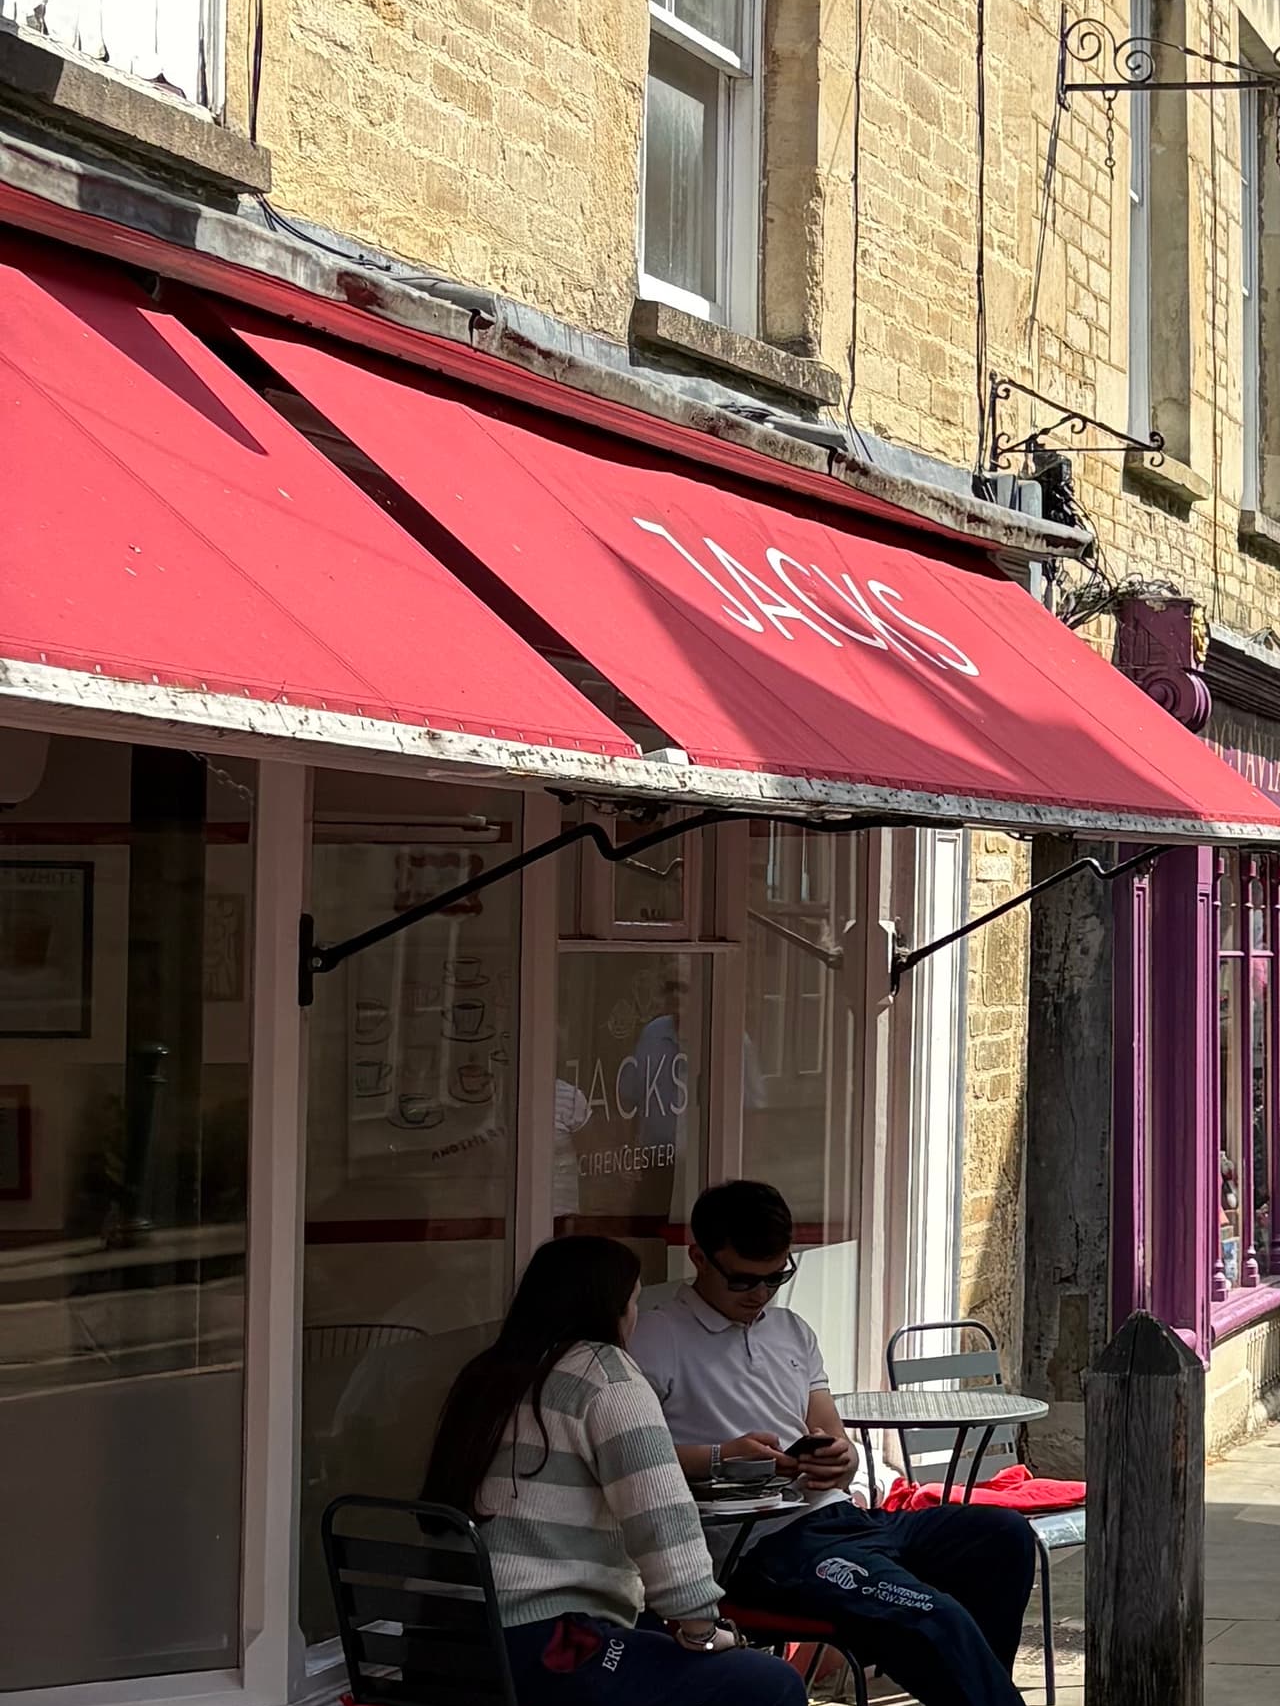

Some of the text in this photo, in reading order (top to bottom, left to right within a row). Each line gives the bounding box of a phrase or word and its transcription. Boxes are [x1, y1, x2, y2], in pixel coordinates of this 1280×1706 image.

[633, 516, 980, 678] JACKS
[564, 1050, 689, 1129] JACKS
[578, 1142, 675, 1178] CIRENCESTER
[861, 1586, 934, 1612] OF NEW ZEALAND
[878, 1580, 933, 1602] CANTERBURY
[601, 1637, 625, 1672] ERC
